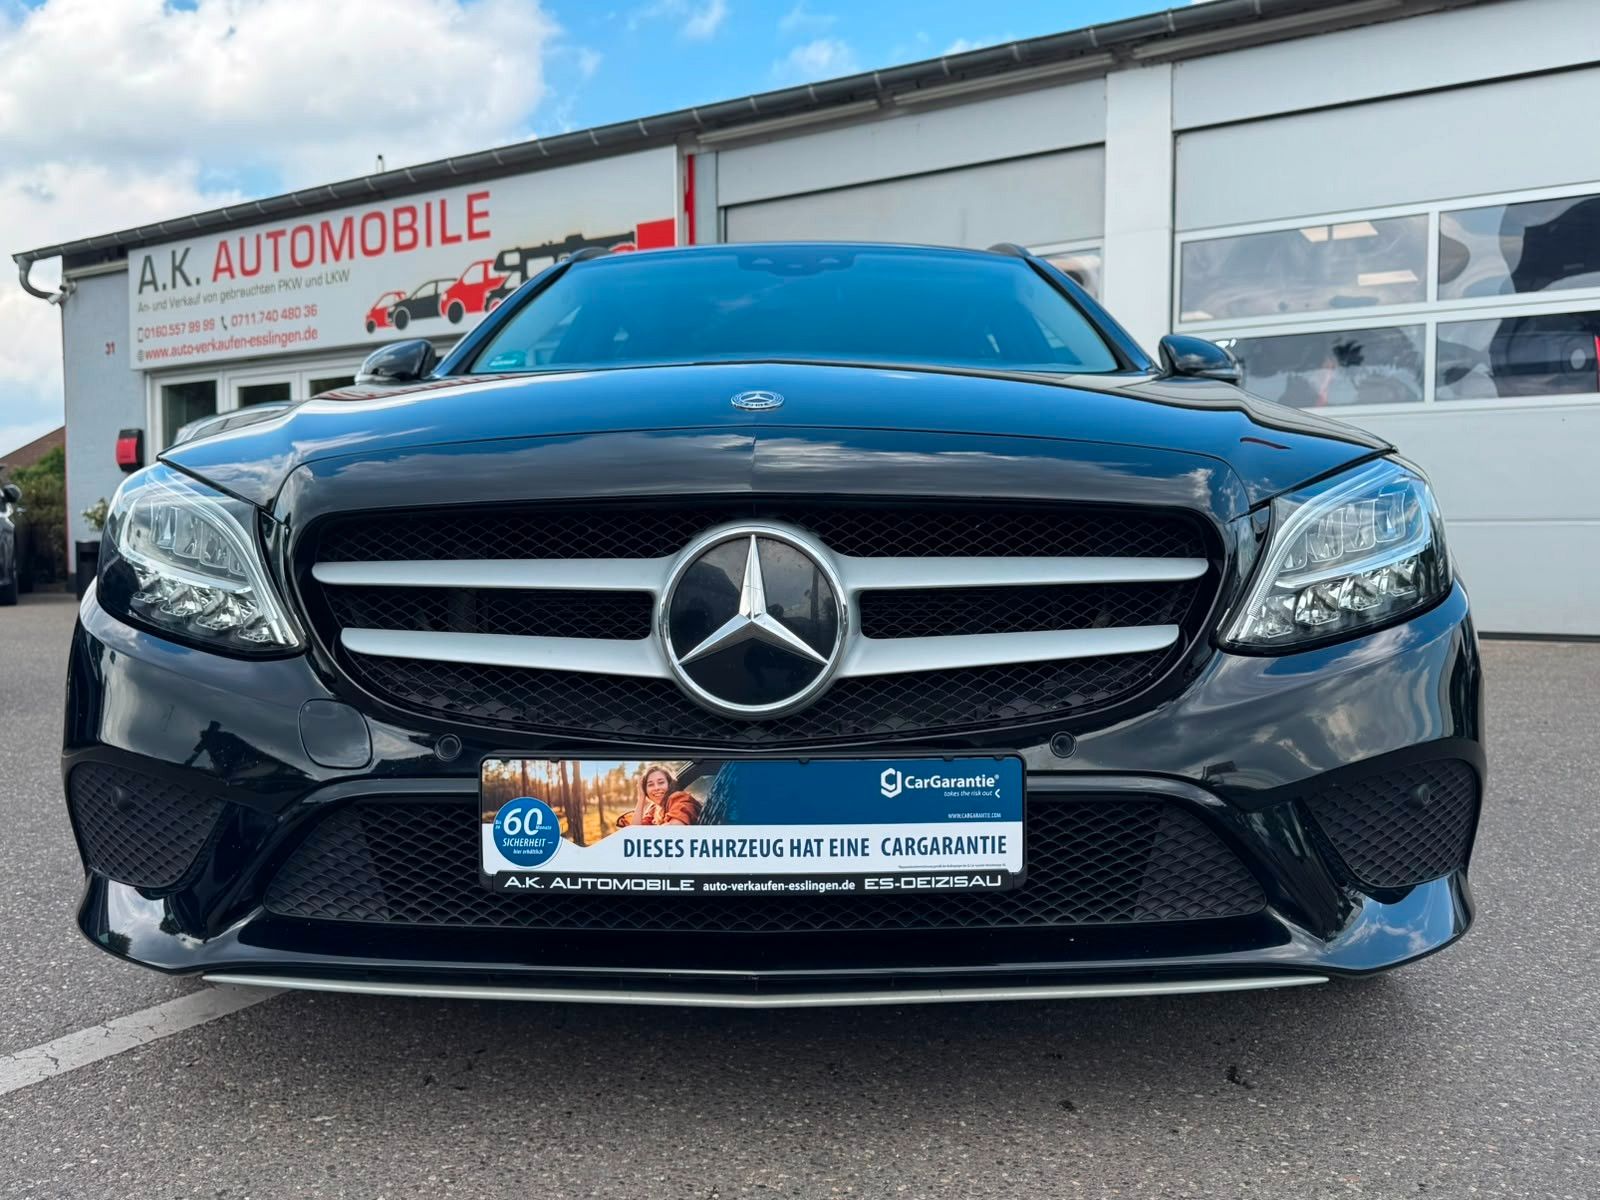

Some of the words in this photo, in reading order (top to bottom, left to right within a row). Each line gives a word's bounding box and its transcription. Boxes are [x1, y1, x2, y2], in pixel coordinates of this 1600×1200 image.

[138, 247, 201, 294] A.K.
[212, 191, 491, 283] AUTOMOBILE
[153, 298, 168, 310] und
[169, 294, 201, 309] Verkauf
[202, 293, 218, 304] von
[219, 283, 276, 304] gebrauchten
[278, 279, 303, 292] PKW
[305, 277, 323, 289] und
[325, 270, 350, 285] LKW
[202, 318, 215, 331] 99
[231, 312, 279, 328] 0711.740
[281, 308, 301, 320] 480
[303, 304, 318, 317] 36
[145, 327, 319, 360] www.auto-verkaufen-esslingen.de
[961, 789, 970, 797] the
[503, 807, 543, 836] 60
[502, 838, 547, 847] SICHERHEIT
[623, 839, 685, 858] DIESES
[690, 838, 784, 858] FAHRZEUG
[789, 838, 824, 858] HAT
[829, 837, 870, 857] EINE
[880, 835, 1007, 857] CARGARANTIE
[503, 876, 545, 889] A.K.
[549, 878, 695, 891] AUTOMOBILE
[702, 880, 856, 894] auto-verkaufen-esslingen.de
[864, 875, 1002, 890] ES-DEIZISAU
